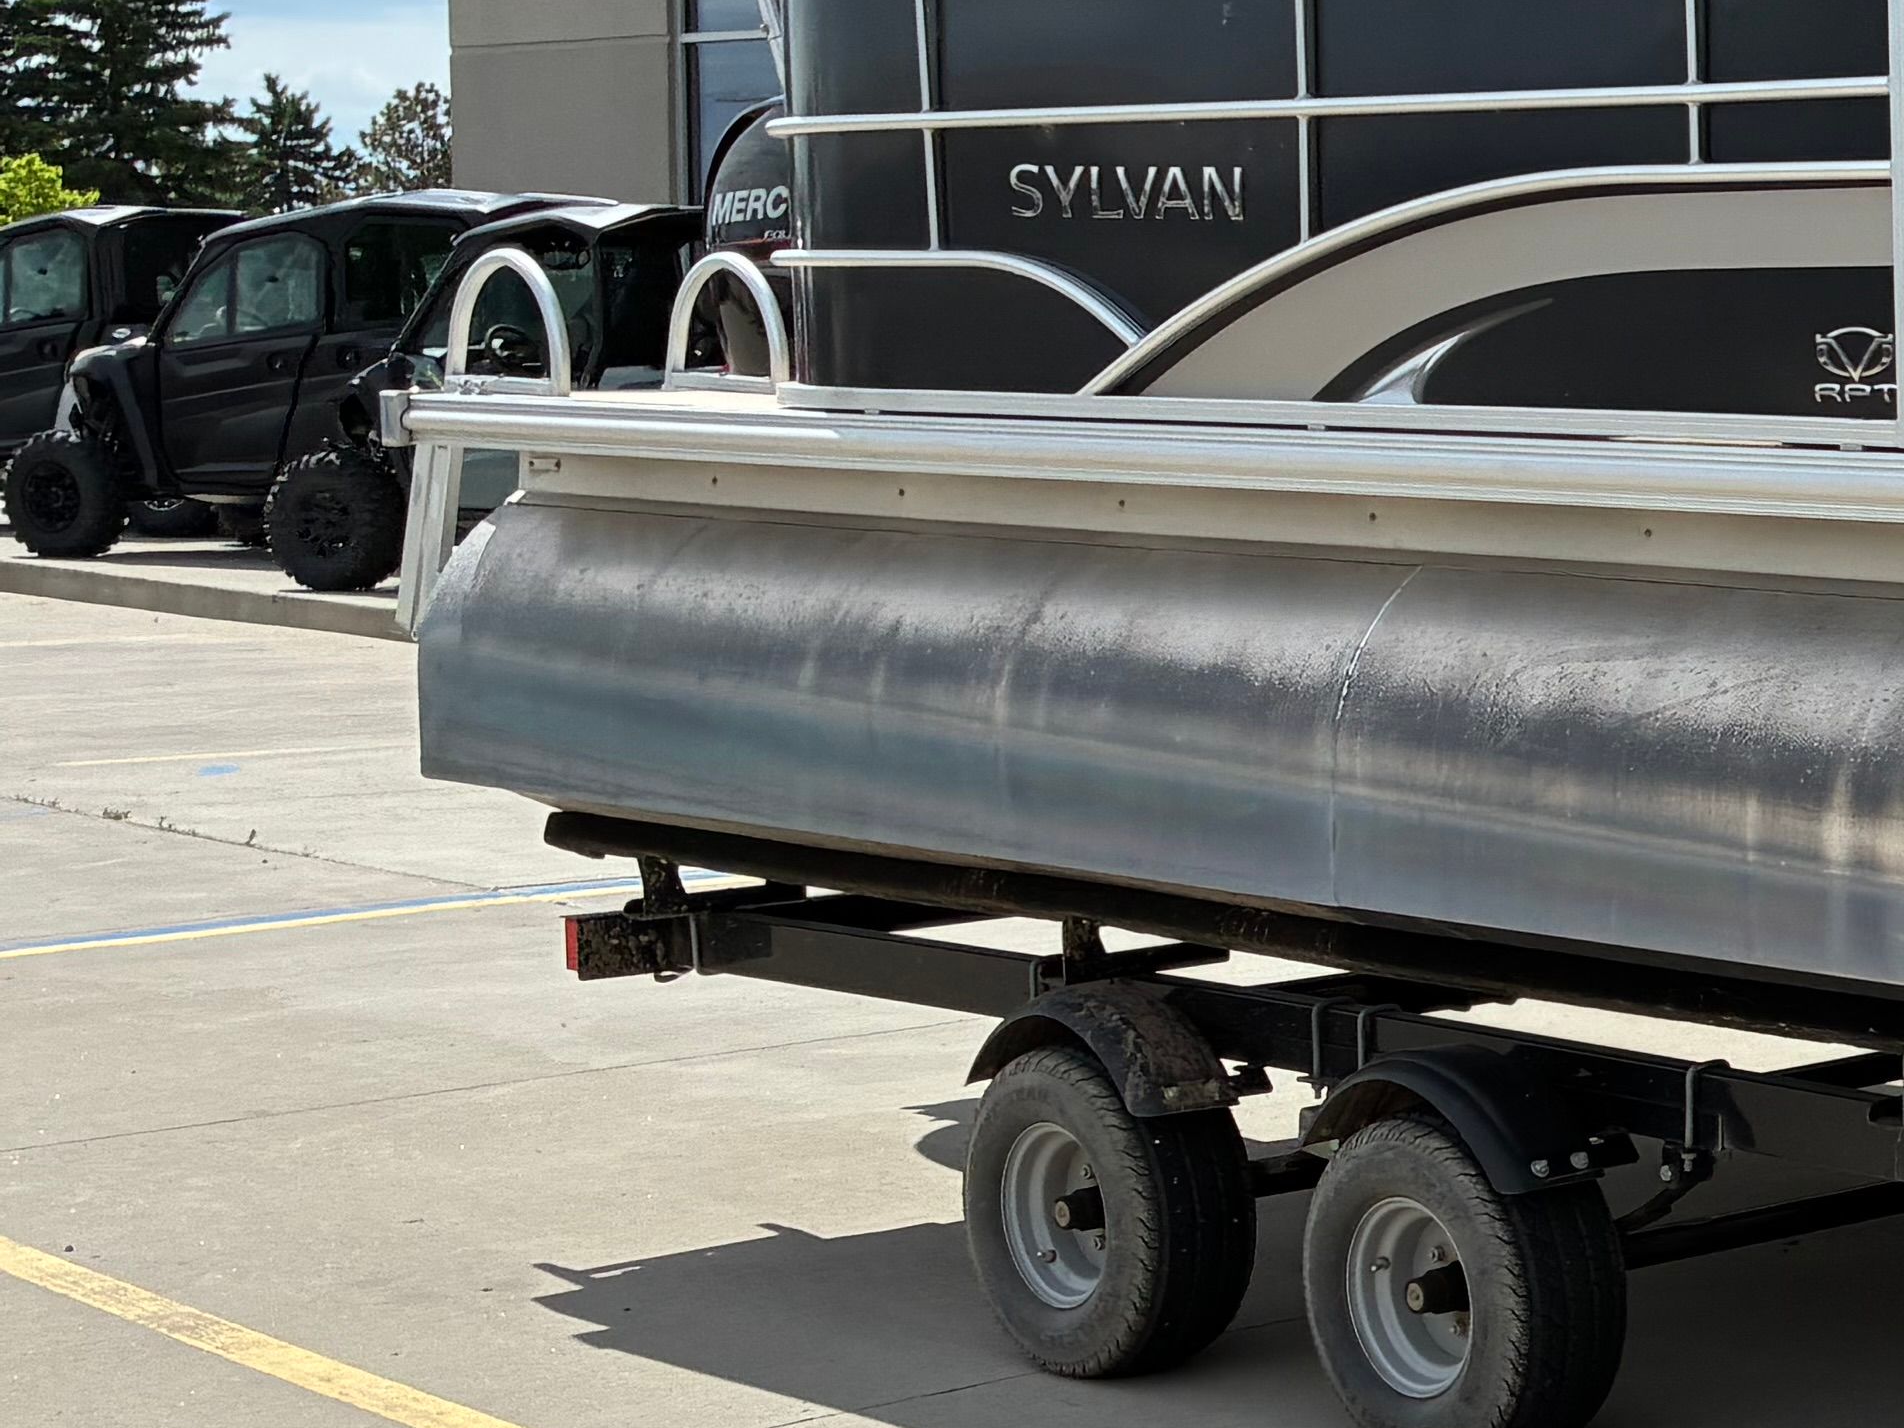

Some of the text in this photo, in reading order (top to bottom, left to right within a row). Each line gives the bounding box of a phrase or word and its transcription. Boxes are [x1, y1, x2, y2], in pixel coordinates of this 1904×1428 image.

[712, 185, 790, 225] MERC
[1009, 163, 1244, 220] SYLVAN
[1814, 383, 1898, 403] RPT
